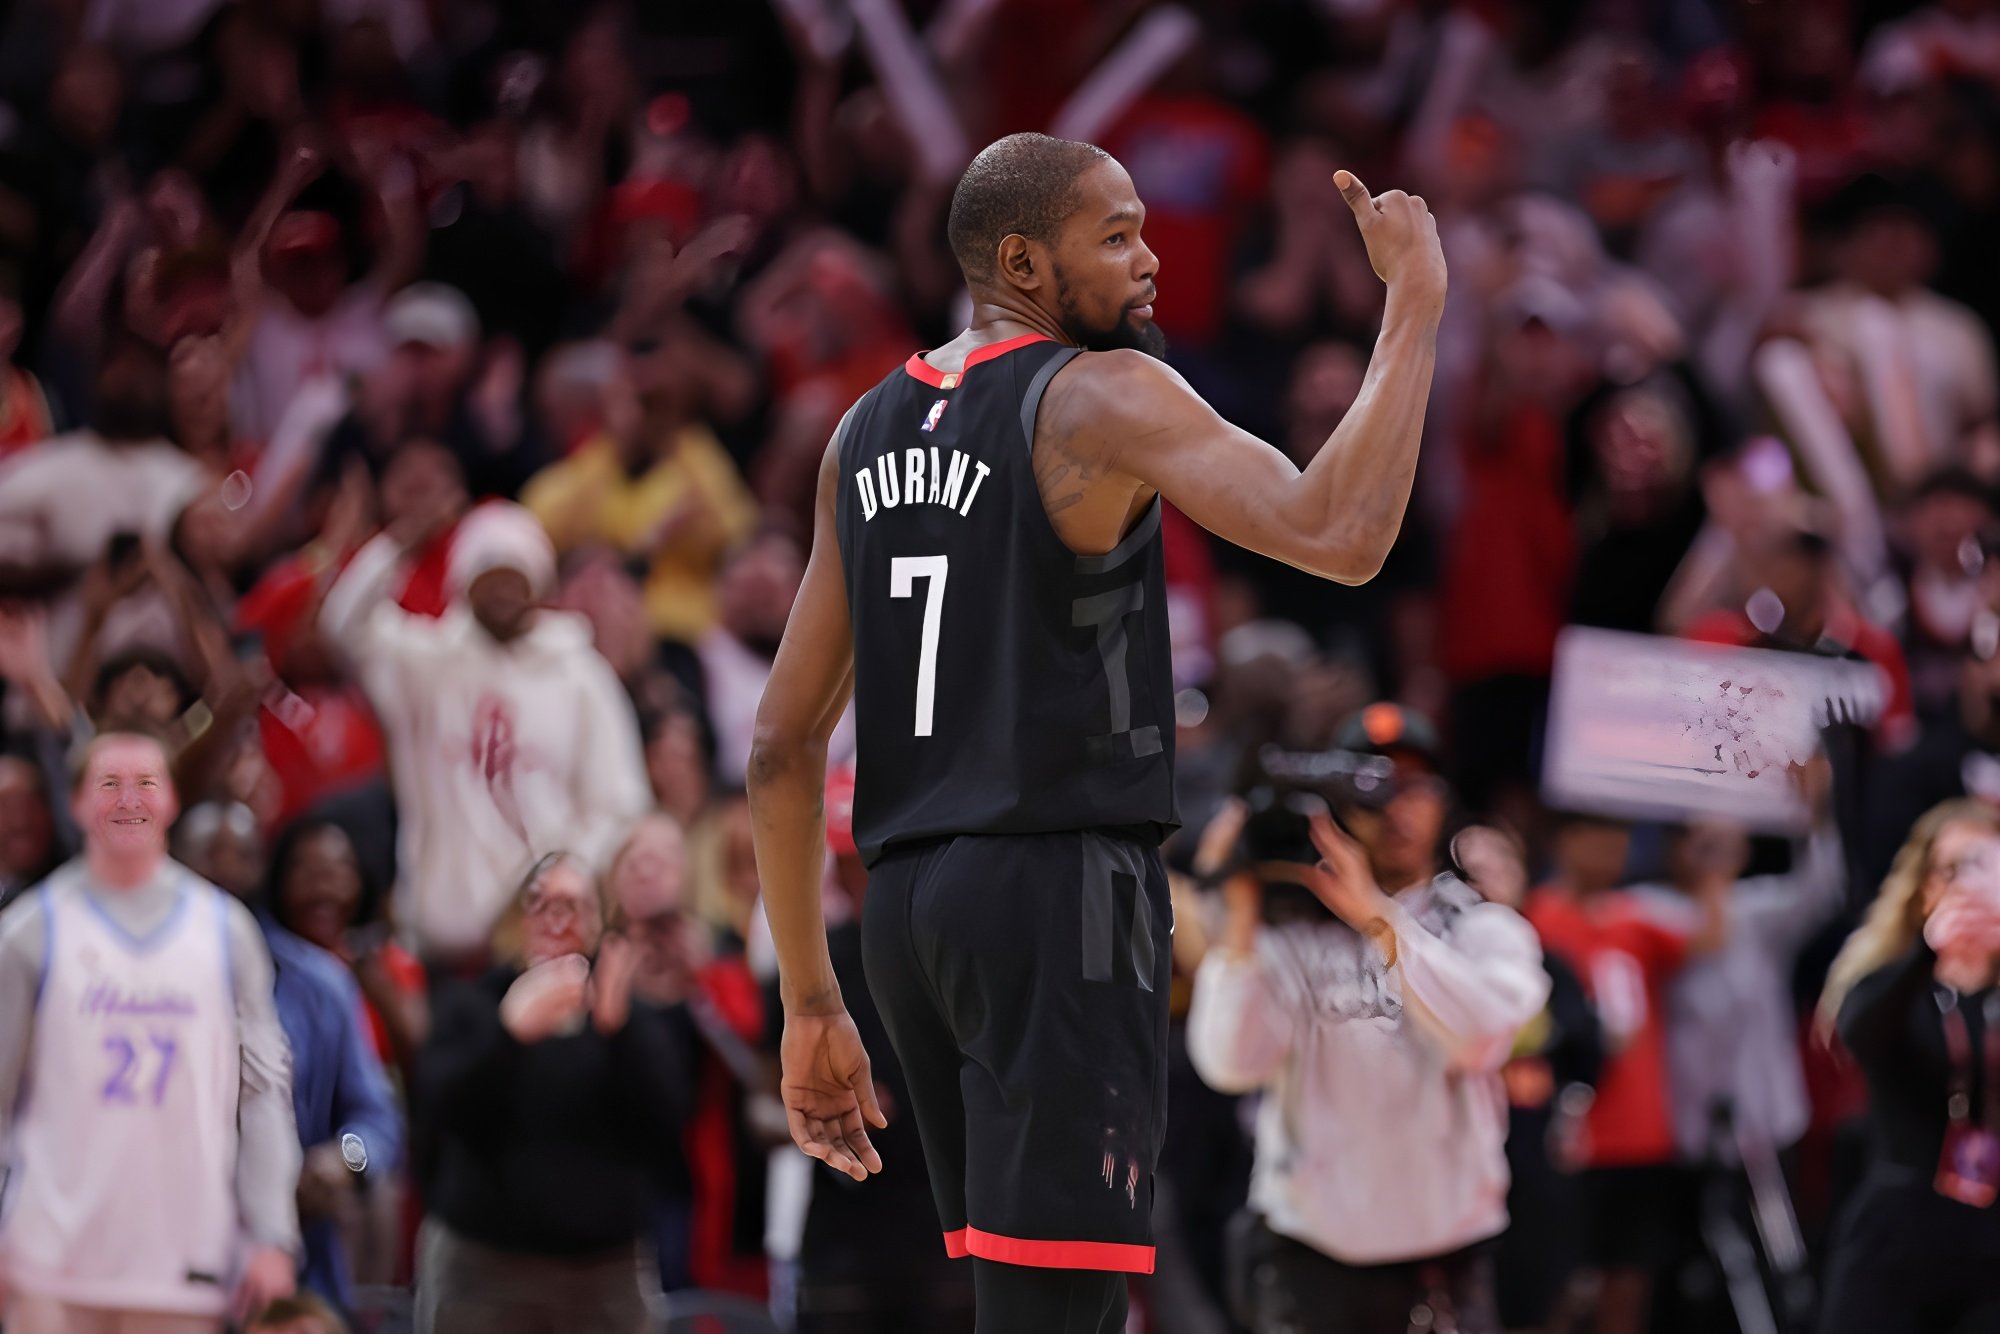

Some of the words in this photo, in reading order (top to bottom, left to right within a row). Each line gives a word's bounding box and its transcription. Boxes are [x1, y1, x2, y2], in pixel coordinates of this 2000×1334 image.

[856, 447, 991, 522] DURANT
[890, 555, 948, 736] 7
[102, 1034, 176, 1106] 27
